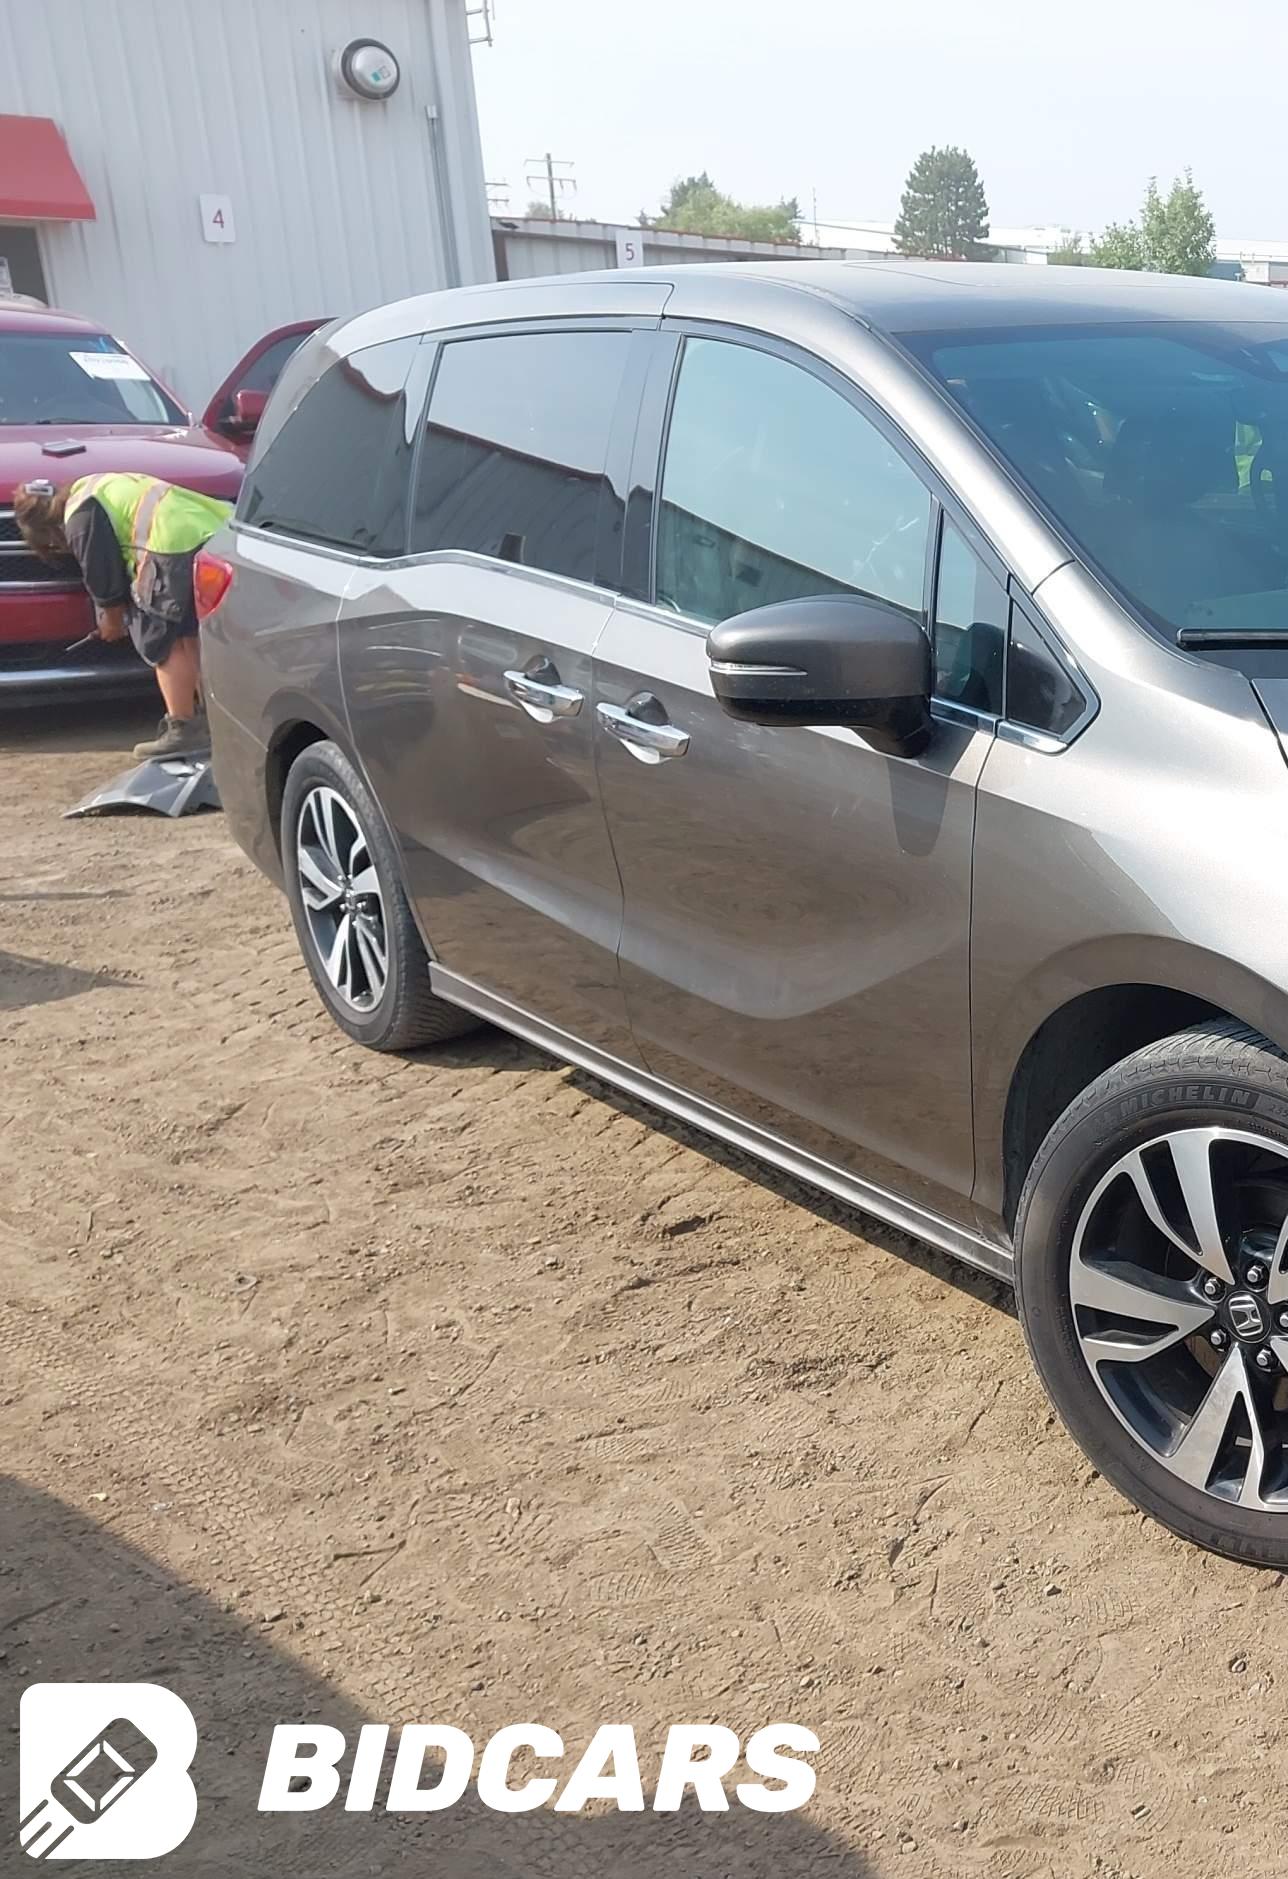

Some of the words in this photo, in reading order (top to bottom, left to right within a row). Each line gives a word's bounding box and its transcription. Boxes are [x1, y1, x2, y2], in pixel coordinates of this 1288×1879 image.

[212, 208, 224, 229] 4
[625, 242, 634, 261] 5
[1120, 1085, 1250, 1117] MICHELIN
